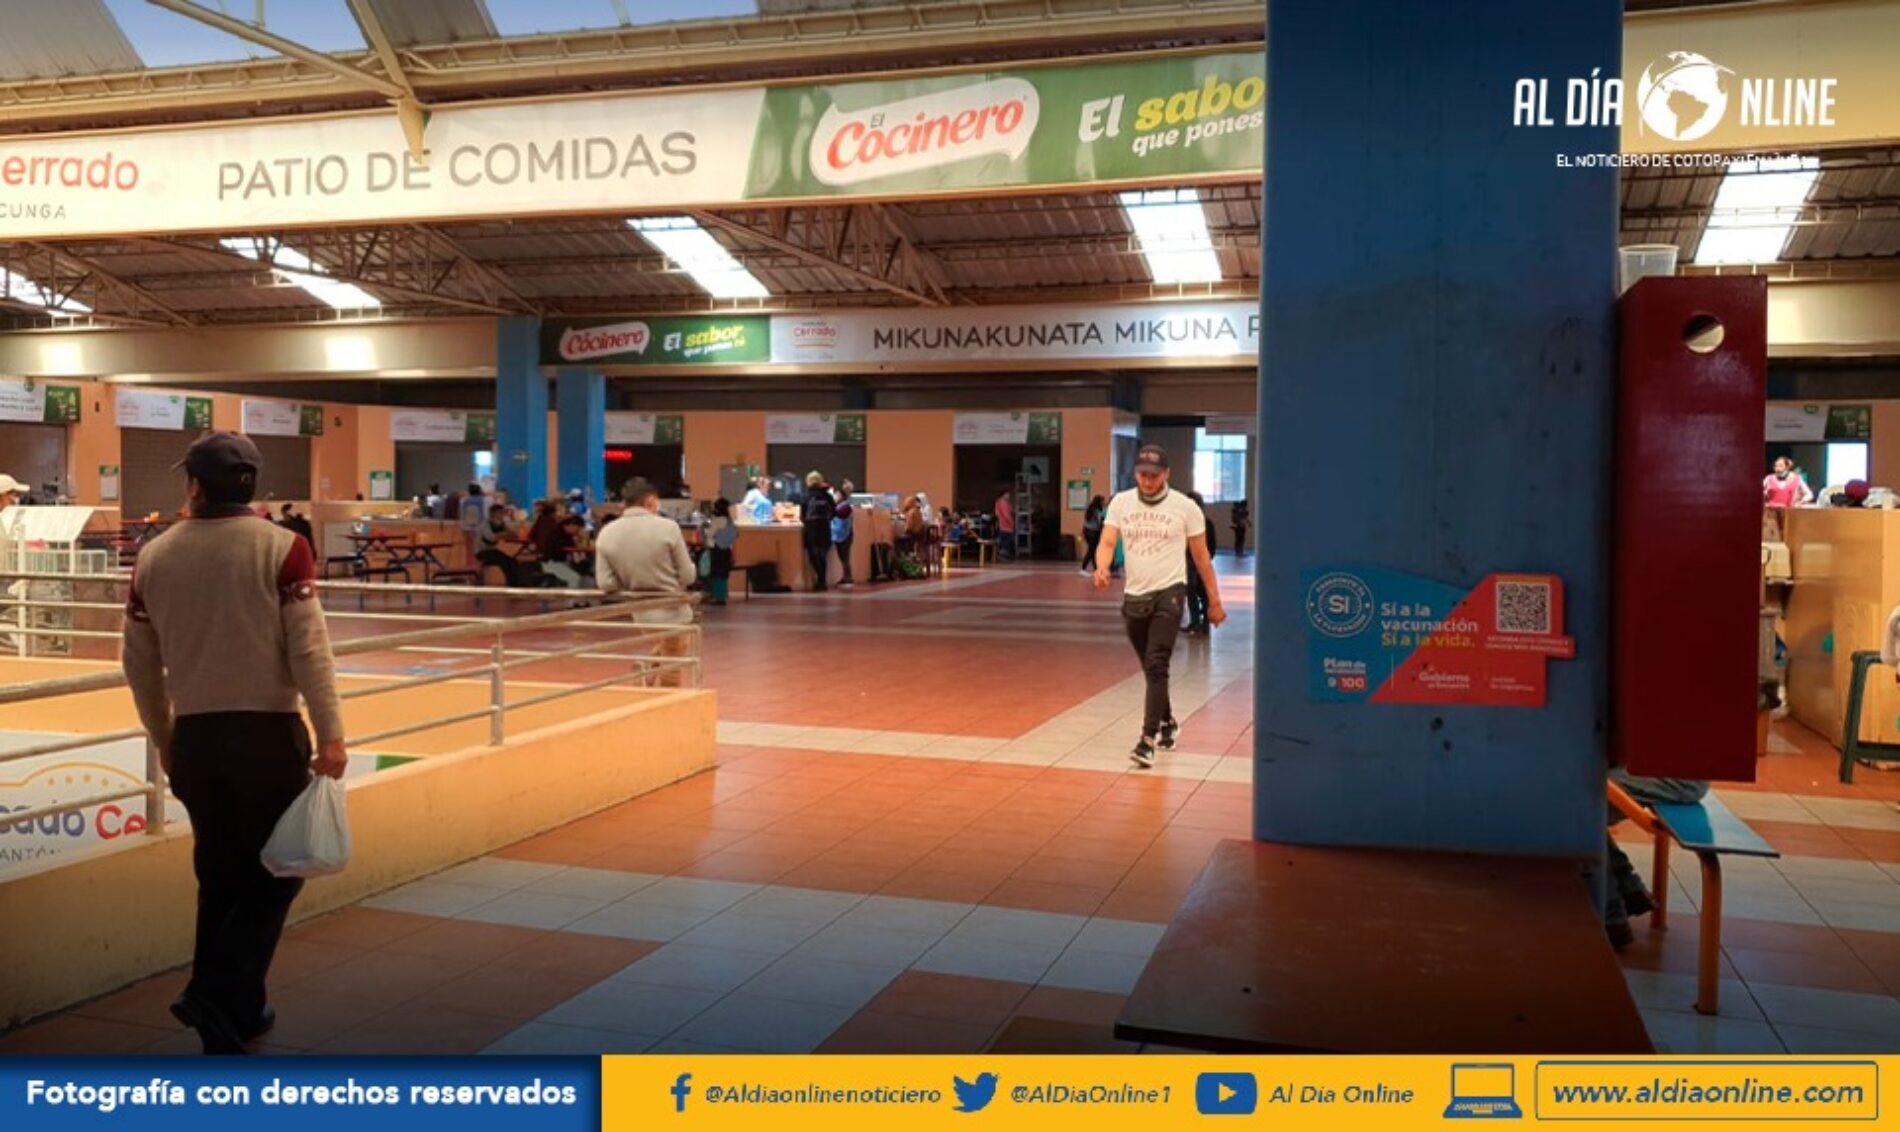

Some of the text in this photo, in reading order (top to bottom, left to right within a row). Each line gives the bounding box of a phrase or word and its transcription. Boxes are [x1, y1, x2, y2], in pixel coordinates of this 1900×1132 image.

[1079, 73, 1265, 142] El sabo
[827, 100, 1024, 169] Cocinero
[1132, 110, 1264, 158] que pones
[2, 152, 139, 192] errado
[218, 131, 697, 201] PATIO DE COMIDAS
[663, 333, 682, 352] El
[874, 322, 1103, 349] MIKUNAKUNATA
[1115, 317, 1238, 344] MIKUNA
[1381, 617, 1478, 633] vacunación
[1400, 605, 1411, 617] a
[1415, 602, 1431, 617] la
[1400, 636, 1411, 647] a
[1415, 632, 1431, 647] la
